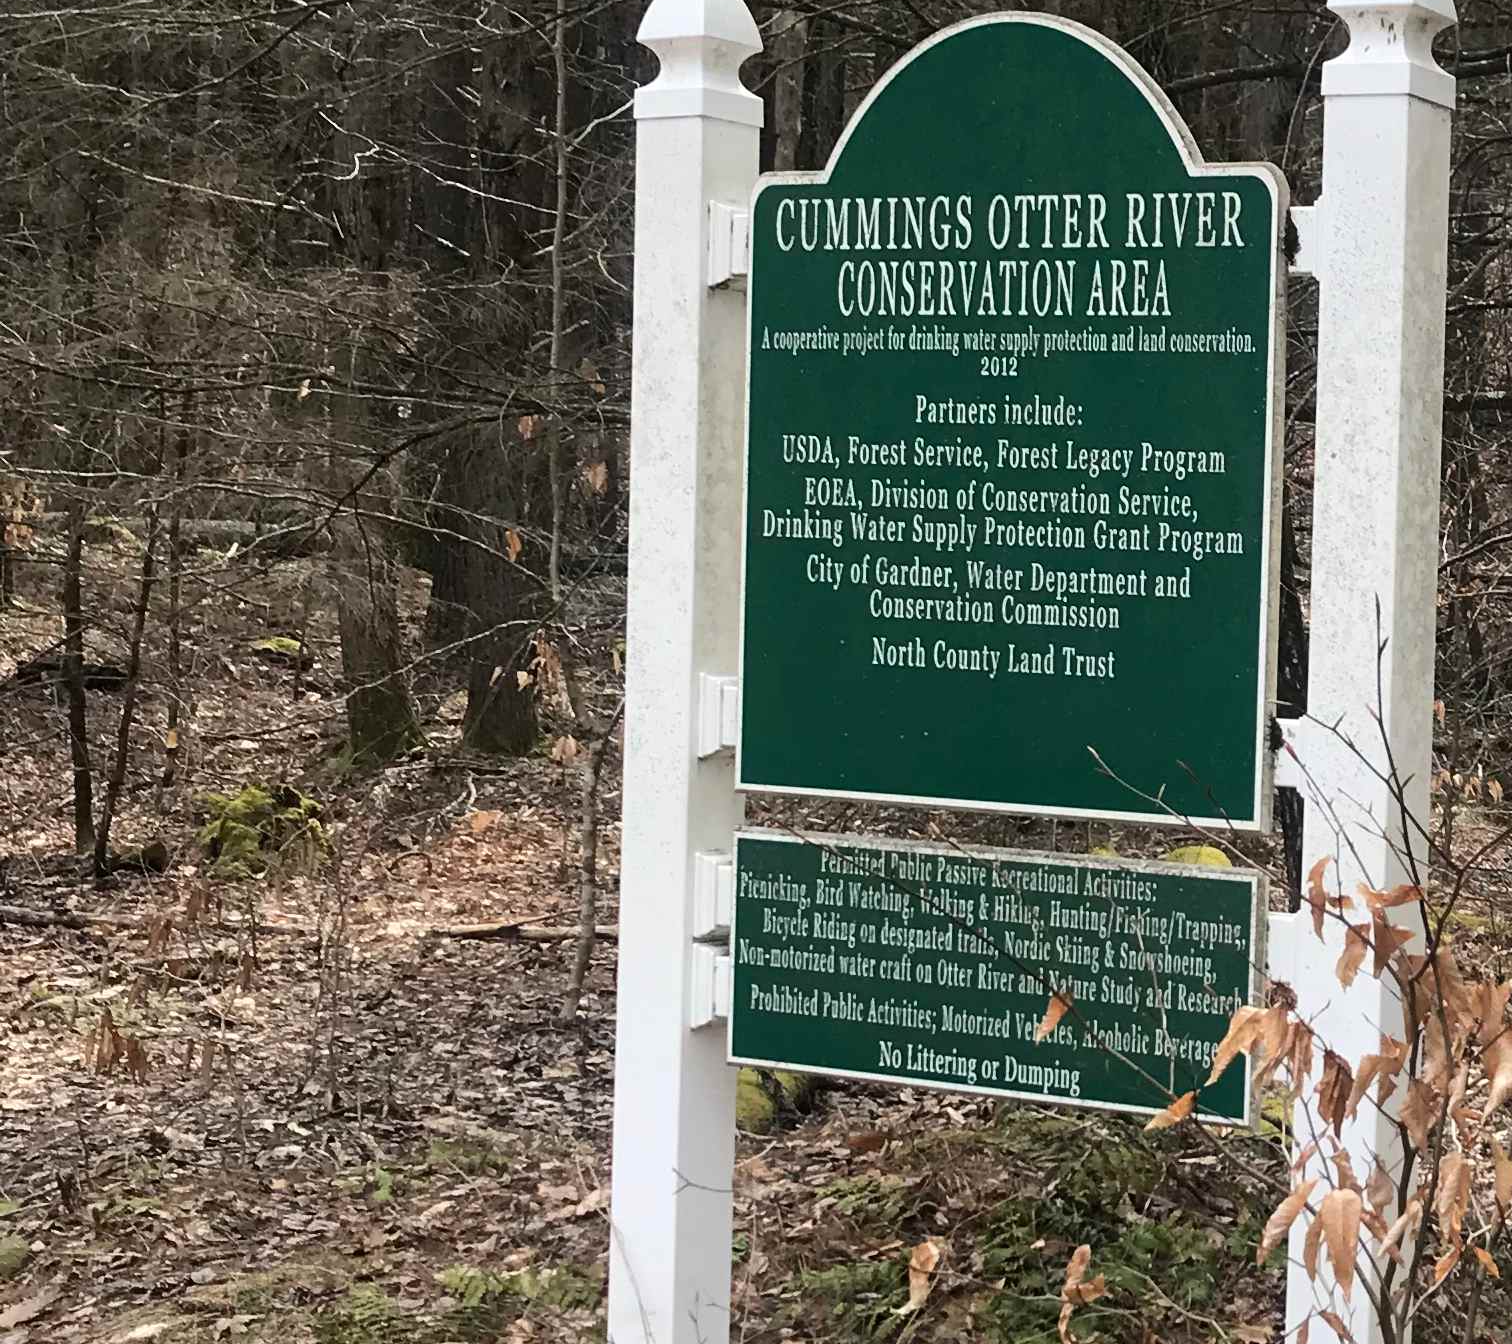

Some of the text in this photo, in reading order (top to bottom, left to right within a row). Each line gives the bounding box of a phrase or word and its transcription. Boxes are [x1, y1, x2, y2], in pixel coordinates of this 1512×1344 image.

[776, 192, 1245, 251] CUMMINGS OTTER RIVER
[838, 259, 1171, 317] CONSERVATION AREA
[761, 325, 1256, 357] A cooperative project for drinking water supply protection and land conservation.
[981, 356, 1017, 376] 2012
[916, 394, 1082, 426] Partners include:
[783, 435, 1225, 480] USDA, Forest Service, Forest Legacy Program
[805, 477, 1197, 523] EOEA, Division of Conservation Service,
[763, 509, 1243, 561] Drinking Water Supply Protection Grant Program
[807, 552, 1190, 599] City of Gardner, Water Department and
[870, 589, 1119, 628] Conservation Commission
[872, 637, 1115, 679] North County Land Trust
[820, 848, 1157, 902] Permitted Public Passive Recreational Activities:
[816, 878, 844, 906] Bird
[848, 882, 914, 919] Watching,
[920, 888, 974, 926] Walking
[979, 893, 989, 920] &
[763, 908, 1216, 985] Bicycle Riding on designated trails, Nordic Skiing & Snowshoeing,
[739, 938, 835, 973] Non-motorized
[839, 953, 876, 977] water
[880, 954, 911, 981] craft
[916, 964, 932, 984] on
[937, 959, 972, 987] Otter
[978, 963, 1014, 992] River
[1018, 967, 1043, 995] and
[1048, 970, 1096, 1002] Nature
[1101, 975, 1142, 1012] Study
[1146, 980, 1175, 1009] and
[751, 984, 818, 1016] Prohibited
[823, 992, 864, 1021] Public
[867, 998, 936, 1034] Activities;
[941, 1005, 1010, 1038] Motorized
[1015, 1012, 1078, 1050] Vehles,
[1082, 1020, 1149, 1054] Alcoholic
[879, 1041, 1080, 1097] No Littering or Dumping
